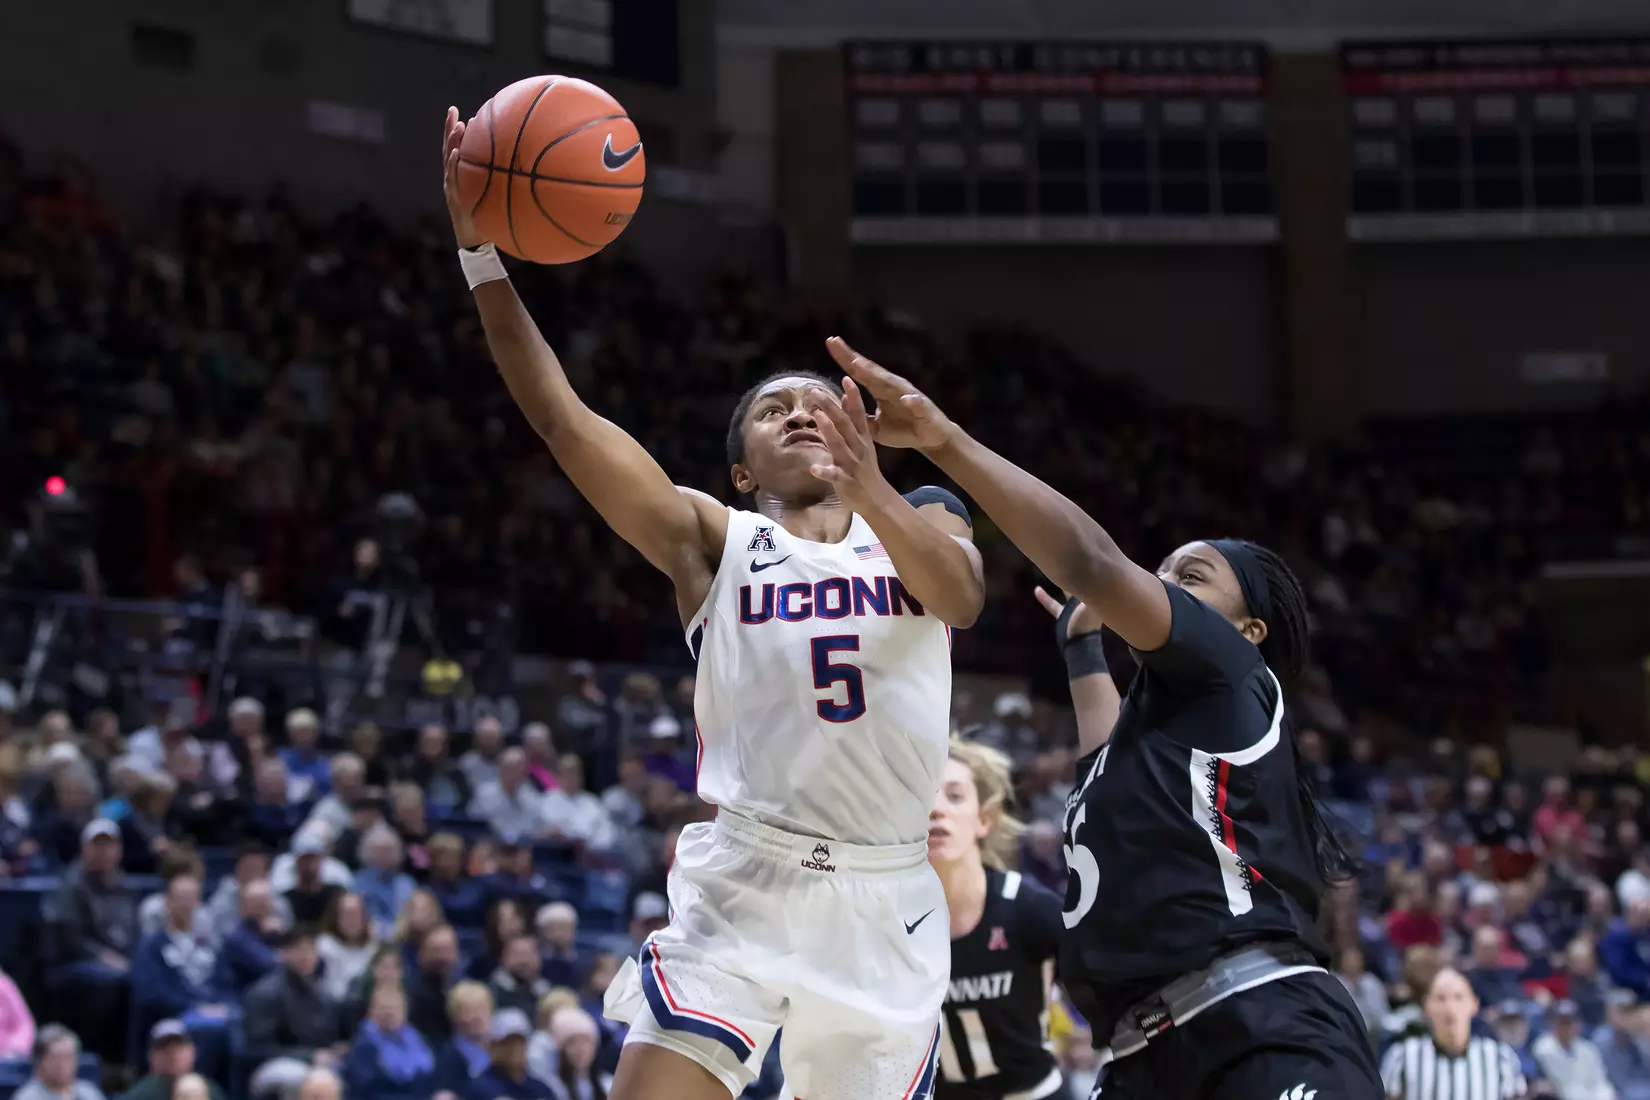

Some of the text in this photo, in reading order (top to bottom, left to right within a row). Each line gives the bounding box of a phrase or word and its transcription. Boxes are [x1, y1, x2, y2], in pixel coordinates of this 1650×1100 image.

[740, 575, 925, 625] UCONN
[810, 634, 867, 723] 5
[801, 859, 836, 874] UCONN
